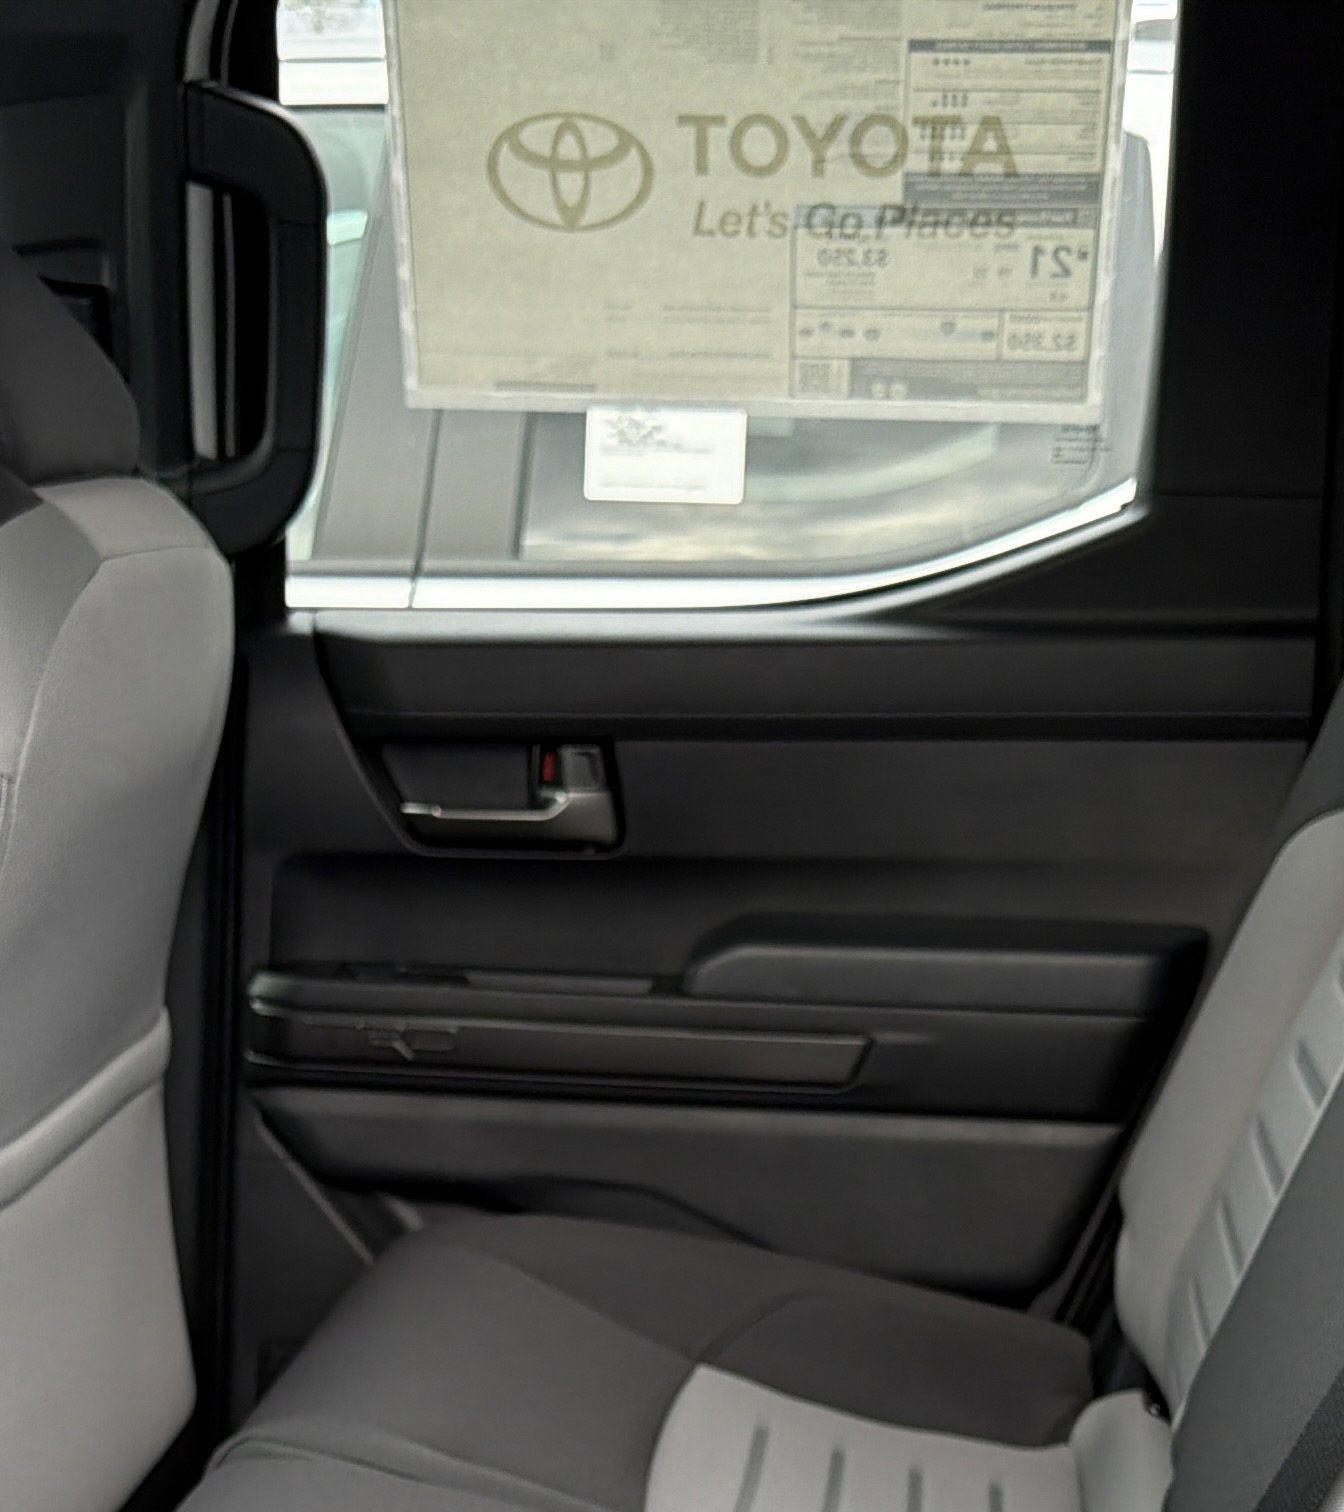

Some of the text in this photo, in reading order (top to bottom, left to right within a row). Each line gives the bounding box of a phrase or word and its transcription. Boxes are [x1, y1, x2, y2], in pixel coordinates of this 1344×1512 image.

[676, 113, 1019, 179] TOYOTA
[694, 200, 1016, 240] Let's Go Places
